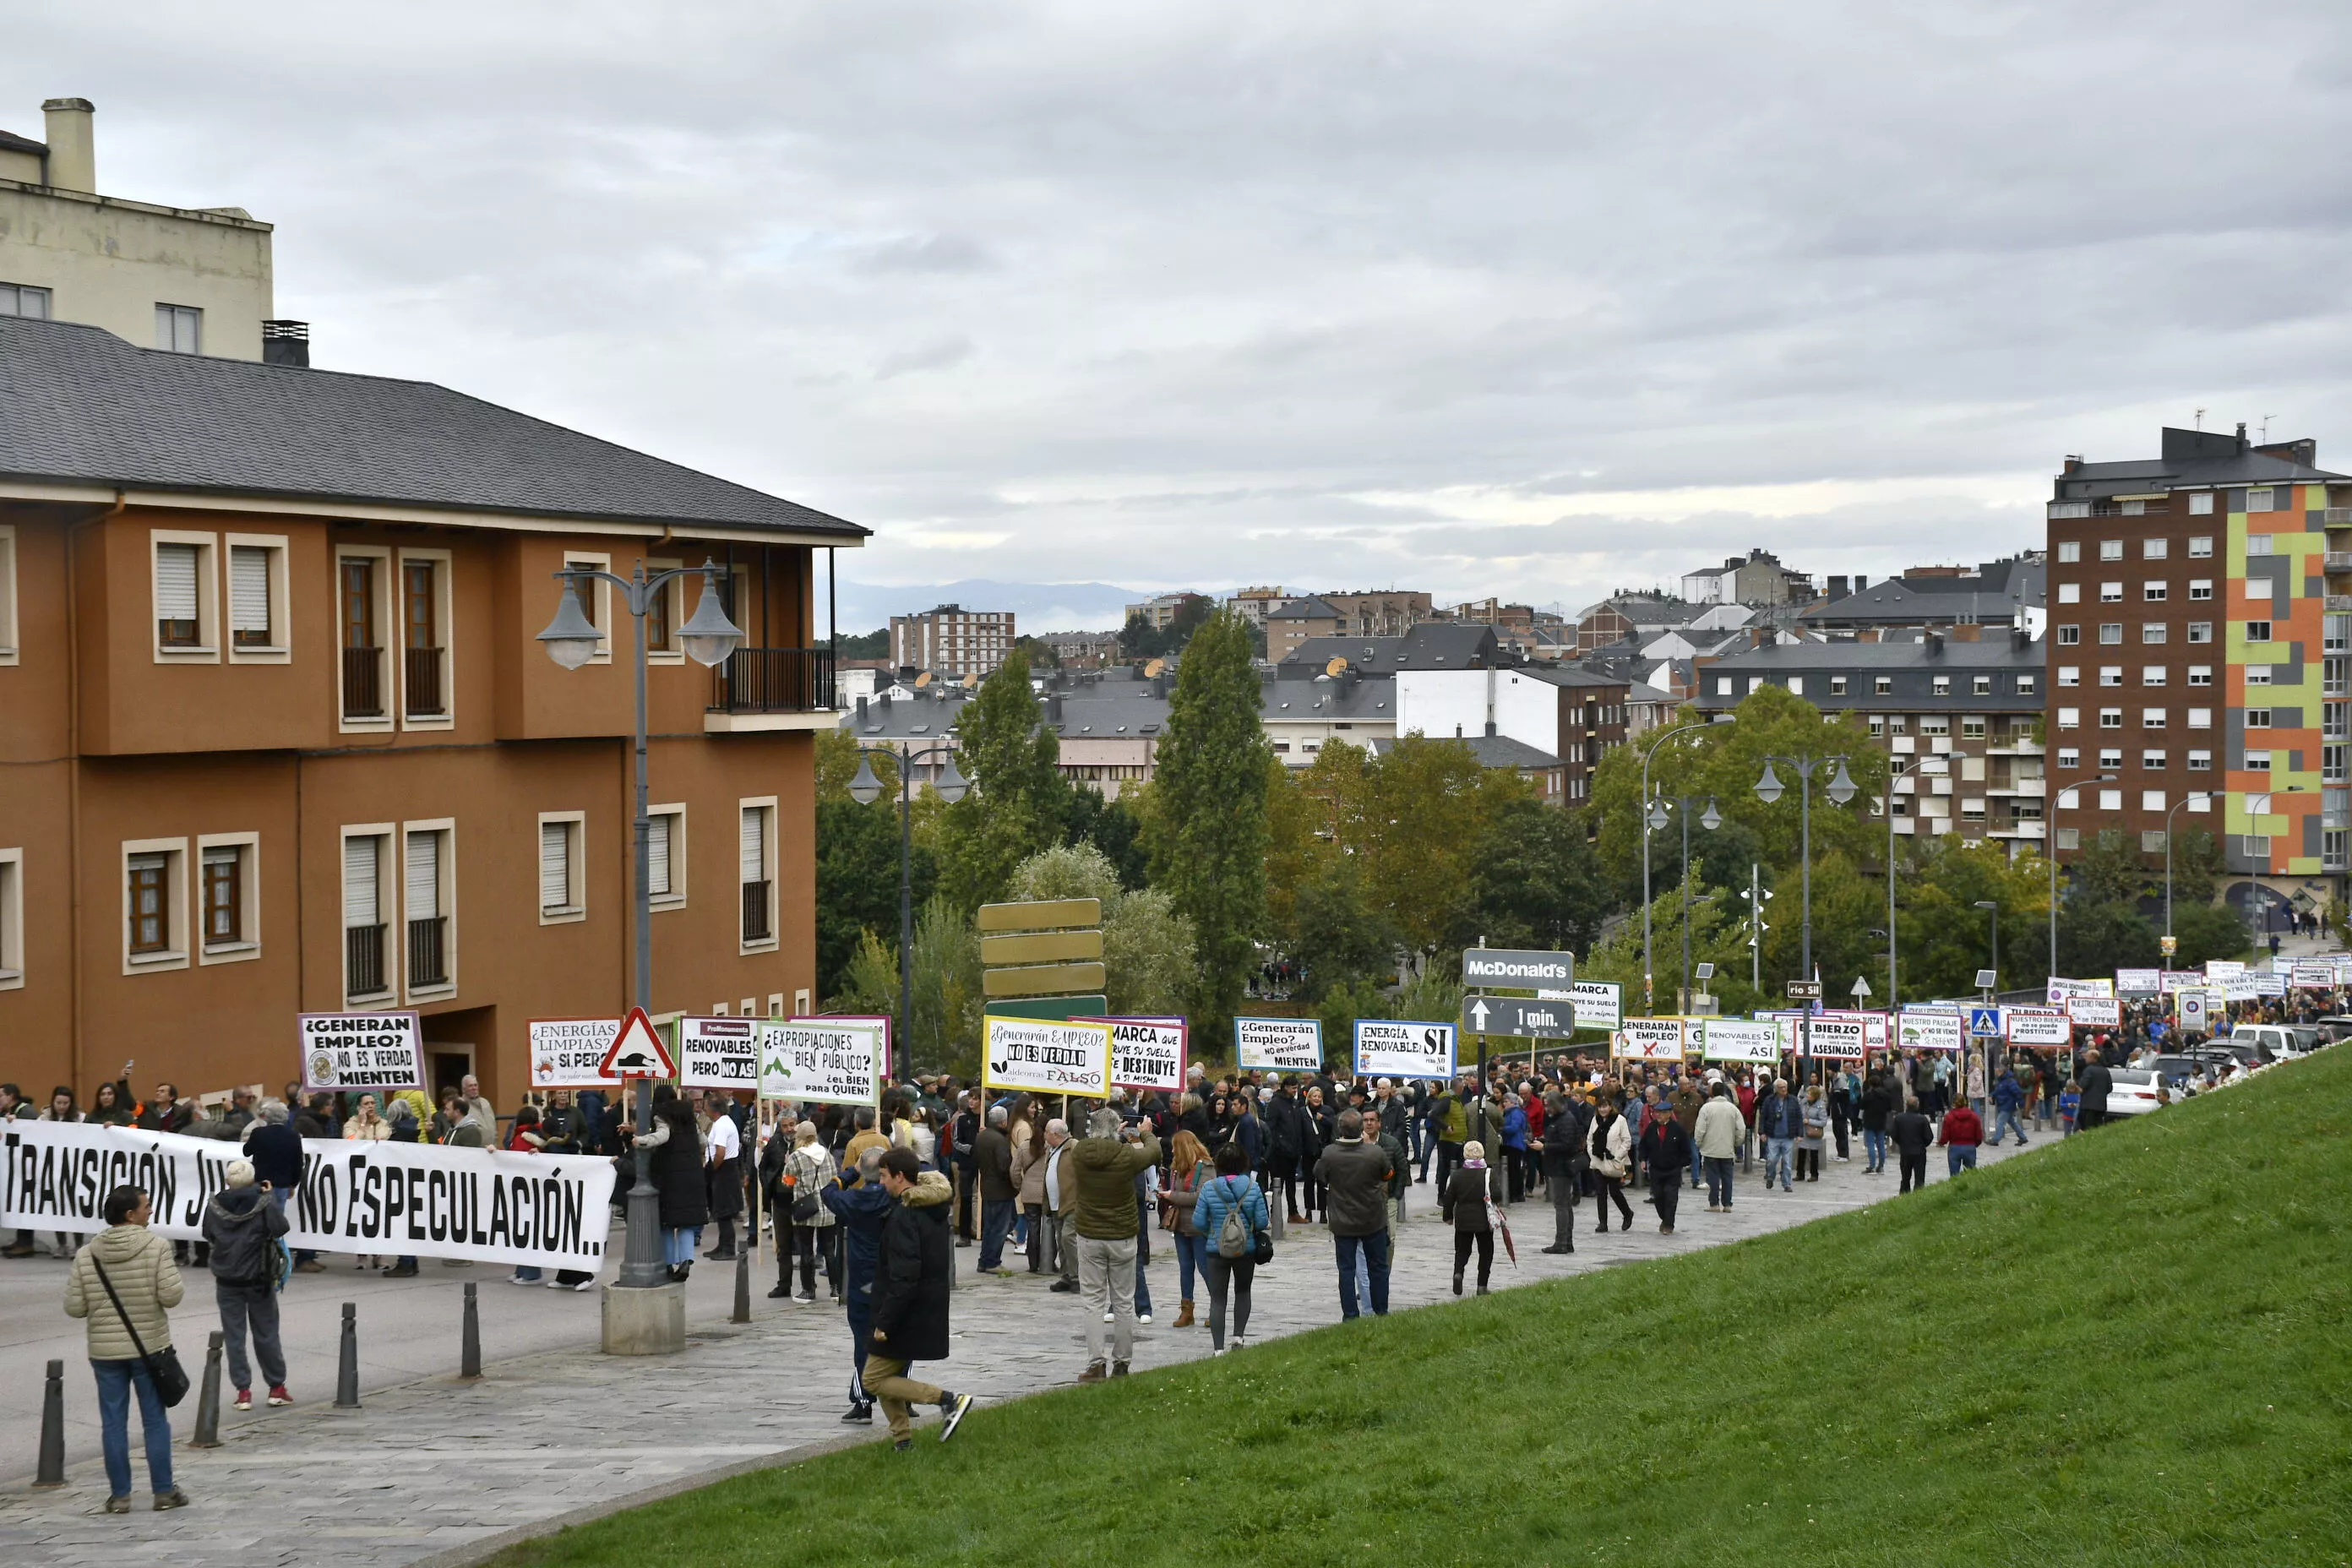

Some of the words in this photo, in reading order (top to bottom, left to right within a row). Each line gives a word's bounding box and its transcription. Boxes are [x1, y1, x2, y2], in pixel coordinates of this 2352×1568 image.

[1468, 961, 1567, 978] McDonald's
[1808, 985, 1819, 994] Sil
[1517, 1009, 1523, 1025] 1
[1527, 1009, 1558, 1027] min.
[1932, 1019, 1957, 1027] PAISAJE
[306, 1018, 410, 1032] ¿GENERAN
[532, 1022, 616, 1040] ¿ENERGÍAS
[1242, 1022, 1314, 1034] ¿Generarán
[1685, 1021, 1702, 1029] Renov
[1815, 1024, 1859, 1034] BIERZO
[314, 1035, 403, 1048] EMPLEO?
[765, 1031, 852, 1050] ¿EXPROPIACIONES
[1113, 1026, 1157, 1043] MARCA
[1162, 1035, 1178, 1045] QUE
[1242, 1033, 1295, 1045] Empleo?
[1636, 1032, 1678, 1041] EMPLEO?
[1708, 1032, 1761, 1040] RENOVABLES
[1865, 1035, 1884, 1044] LACIÓN
[539, 1038, 610, 1051] LIMPIAS?
[686, 1039, 751, 1054] RENOVABLES
[1134, 1046, 1143, 1055] SU
[1286, 1043, 1310, 1053] verdad
[1361, 1041, 1422, 1054] RENOVABLE?
[1656, 1046, 1670, 1055] NO
[1813, 1044, 1861, 1055] ASESINADO
[338, 1051, 351, 1068] NO
[357, 1051, 368, 1067] ES
[374, 1050, 412, 1066] VERDAD
[796, 1048, 818, 1071] BIEN
[1008, 1044, 1023, 1060] NO
[1026, 1045, 1039, 1062] ES
[1042, 1047, 1086, 1066] VERDAD
[1123, 1057, 1175, 1076] DESTRUYE
[1274, 1056, 1317, 1068] MIENTEN
[692, 1062, 719, 1075] PERO
[722, 1062, 737, 1077] NO
[339, 1070, 415, 1085] MIENTEN
[847, 1075, 869, 1086] BIEN
[1047, 1070, 1101, 1085] FALSO
[1133, 1075, 1157, 1085] MISMA
[832, 1086, 870, 1096] QUIEN?
[298, 1152, 337, 1235] NO
